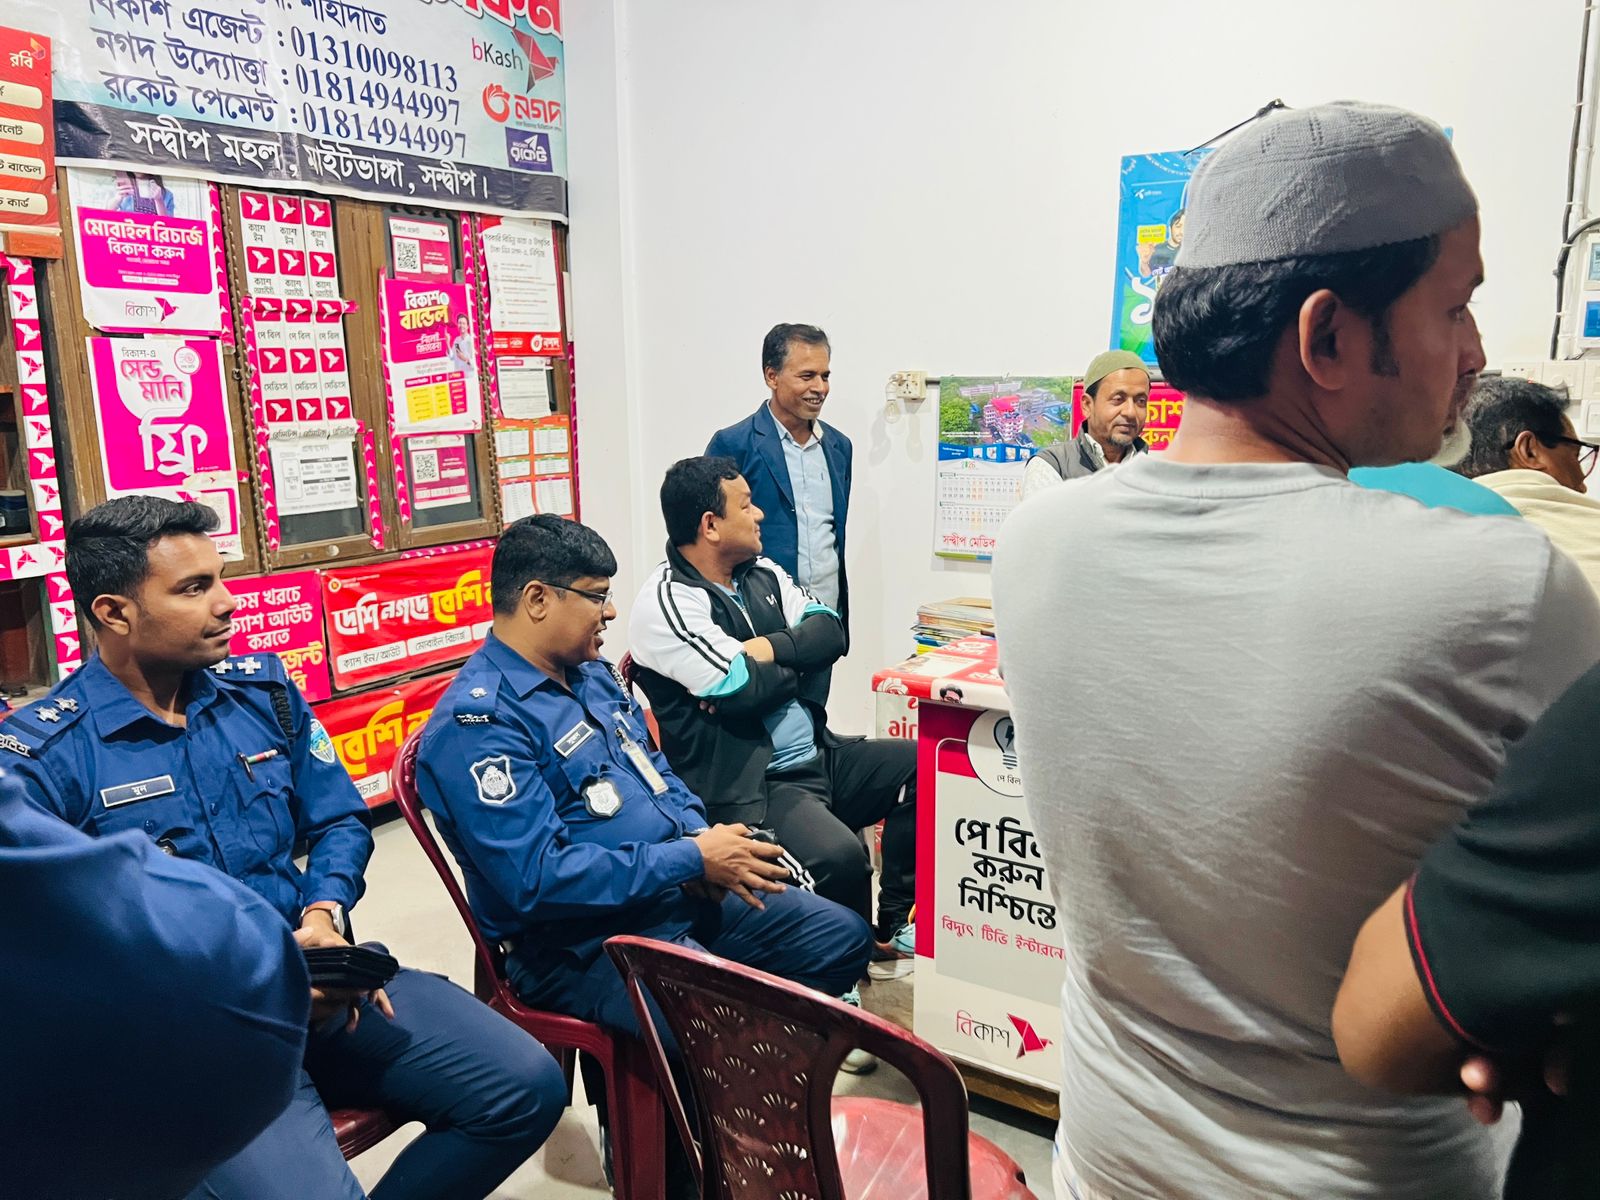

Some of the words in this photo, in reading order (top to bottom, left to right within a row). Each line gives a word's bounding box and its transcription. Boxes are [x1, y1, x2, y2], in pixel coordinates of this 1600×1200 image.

[9, 50, 34, 69] রবি
[182, 8, 266, 44] এজেন্ট
[291, 26, 458, 93] 01310098113
[471, 37, 524, 71] bKash
[90, 27, 157, 69] নগদ
[296, 63, 460, 126] 01814944997
[99, 70, 183, 107] রকেট
[186, 88, 279, 123] পেমেন্ট
[302, 102, 467, 159] 01814944997
[513, 94, 562, 128] নগদ
[125, 114, 213, 162] সন্দ্বীপ
[8, 197, 30, 208] কার্ড
[84, 218, 151, 241] মোবাইল
[153, 221, 203, 246] রিচার্জ
[107, 237, 149, 257] বিকাশ
[151, 246, 185, 260] করুন
[125, 301, 157, 317] বিকাশ
[399, 305, 449, 330] বান্ডেল
[120, 358, 163, 380] সেন্ড
[139, 374, 185, 402] মানি
[138, 407, 208, 477] ফ্রি
[262, 586, 302, 606] খরচে
[331, 592, 380, 636] দেশি
[380, 594, 430, 625] নগদে
[430, 569, 483, 624] বেশি
[266, 602, 313, 627] আউট
[246, 628, 291, 650] করতে
[955, 817, 991, 851] পে
[971, 852, 1045, 891] করুন
[957, 876, 1058, 931] নিশ্চিন্তে
[941, 914, 974, 937] বিদ্যুৎ
[981, 923, 1009, 945] টিভি
[1015, 934, 1067, 960] ইন্টারনে
[956, 1009, 1010, 1049] বিকাশ
